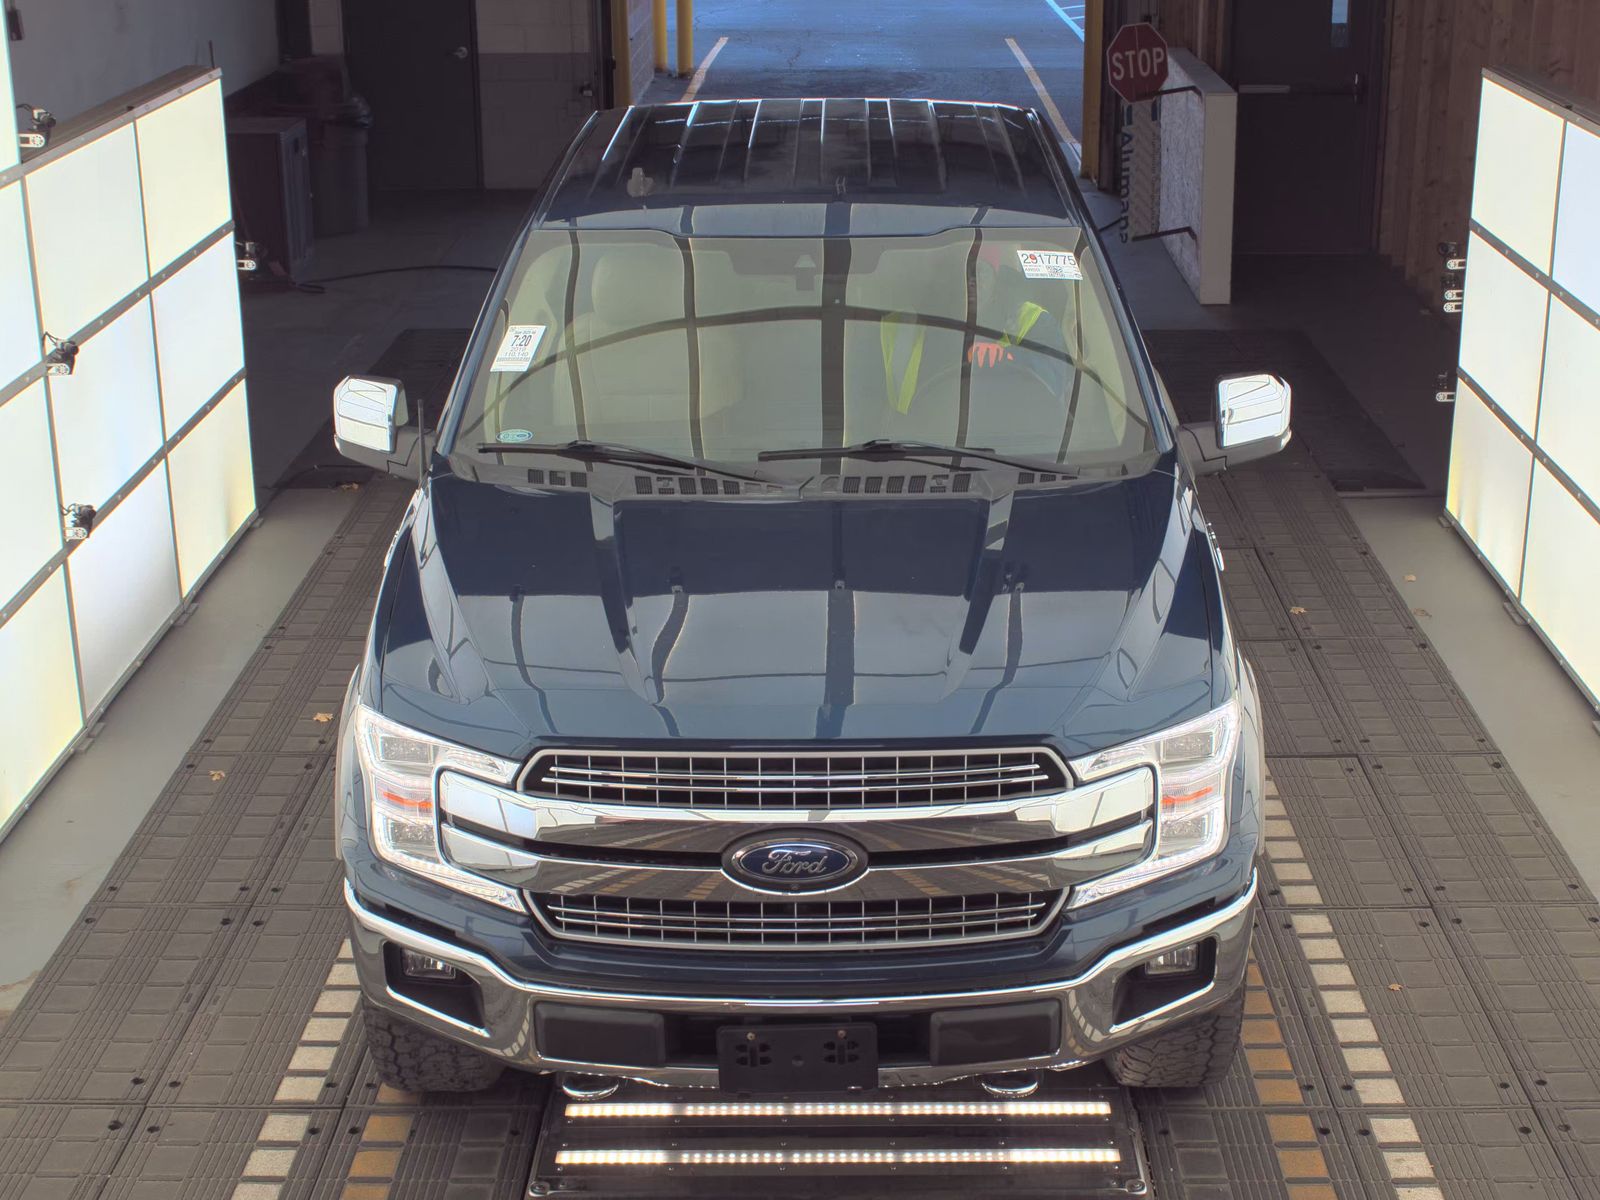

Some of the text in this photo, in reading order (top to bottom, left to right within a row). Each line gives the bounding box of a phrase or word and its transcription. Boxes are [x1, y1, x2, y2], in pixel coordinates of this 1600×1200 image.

[1112, 47, 1165, 80] STOP
[1021, 253, 1077, 266] 2917775
[511, 334, 532, 347] 7:20
[761, 849, 829, 875] Ford
